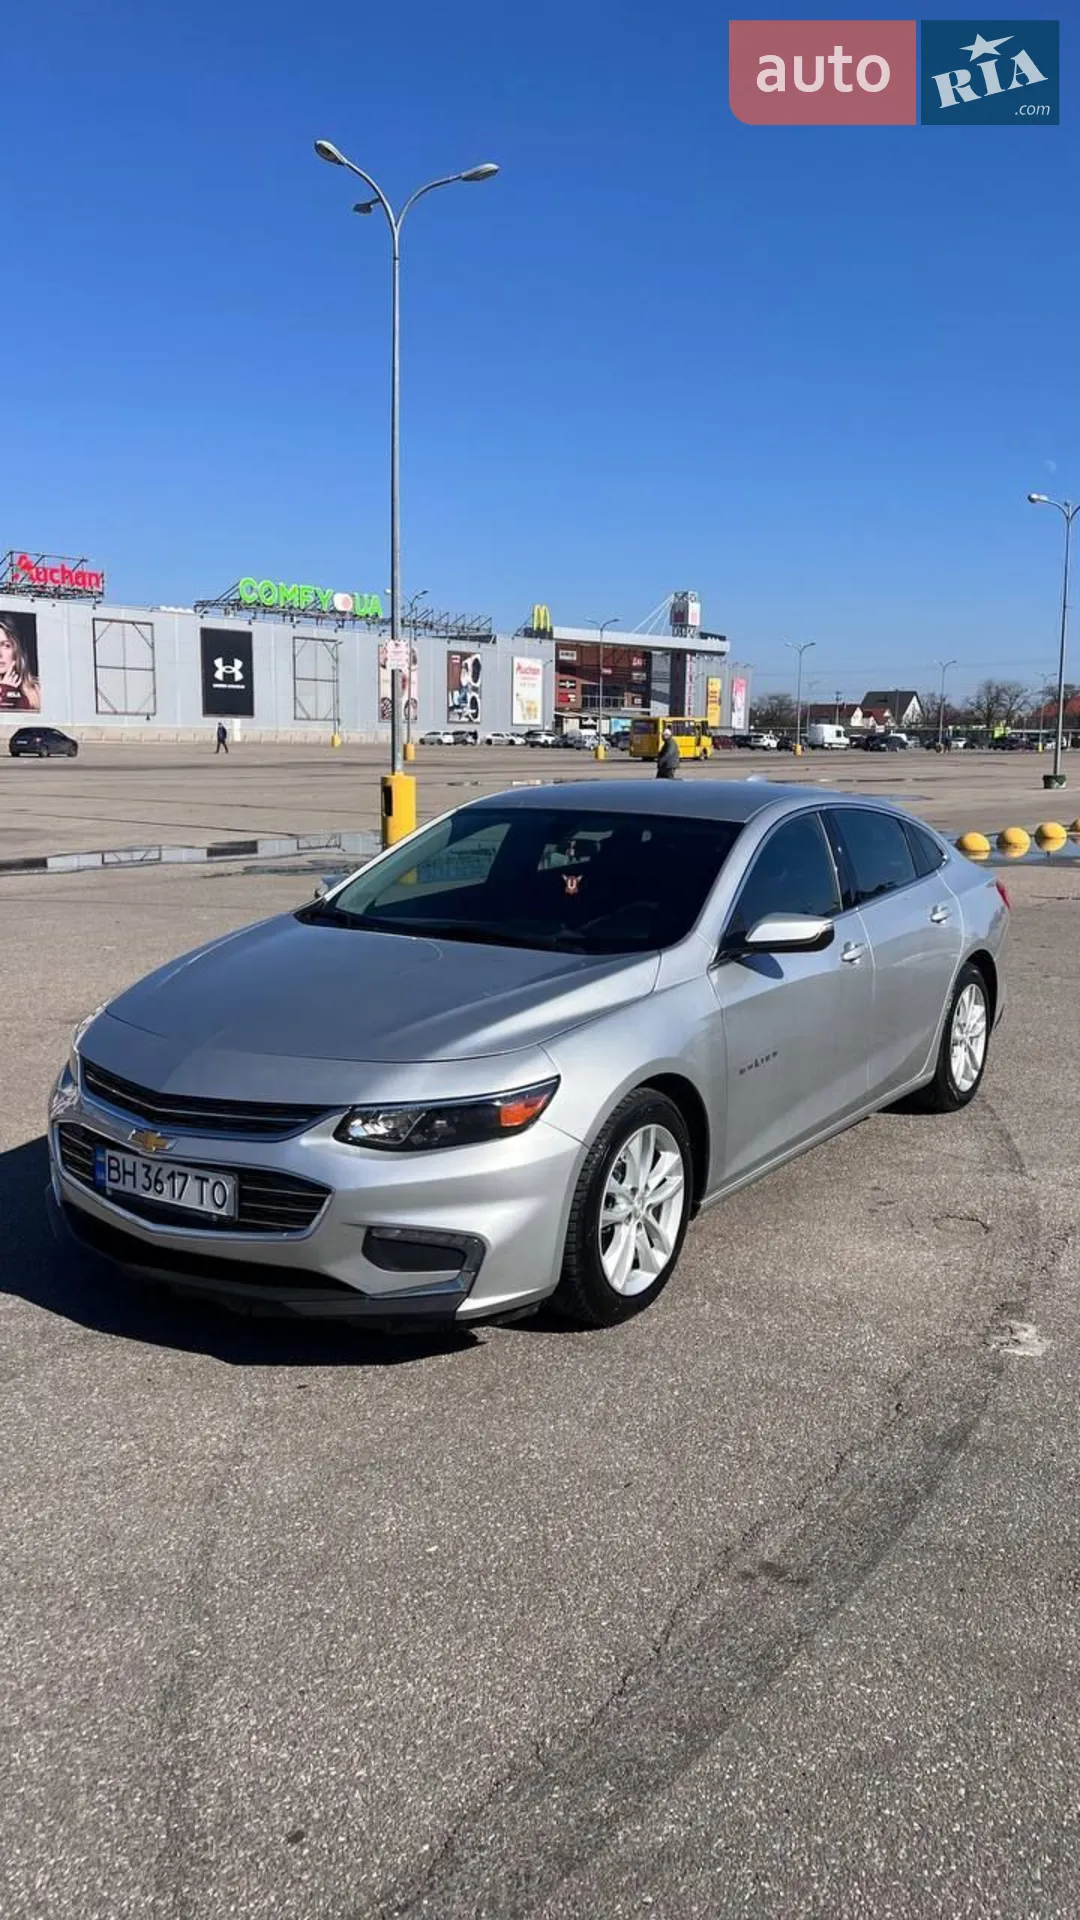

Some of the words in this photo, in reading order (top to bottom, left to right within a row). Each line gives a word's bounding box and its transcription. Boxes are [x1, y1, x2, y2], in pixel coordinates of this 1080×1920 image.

[12, 554, 102, 588] Auchan
[239, 577, 334, 612] COMFY
[107, 1155, 137, 1189] BH
[141, 1163, 190, 1200] 3617
[194, 1175, 228, 1209] TO
